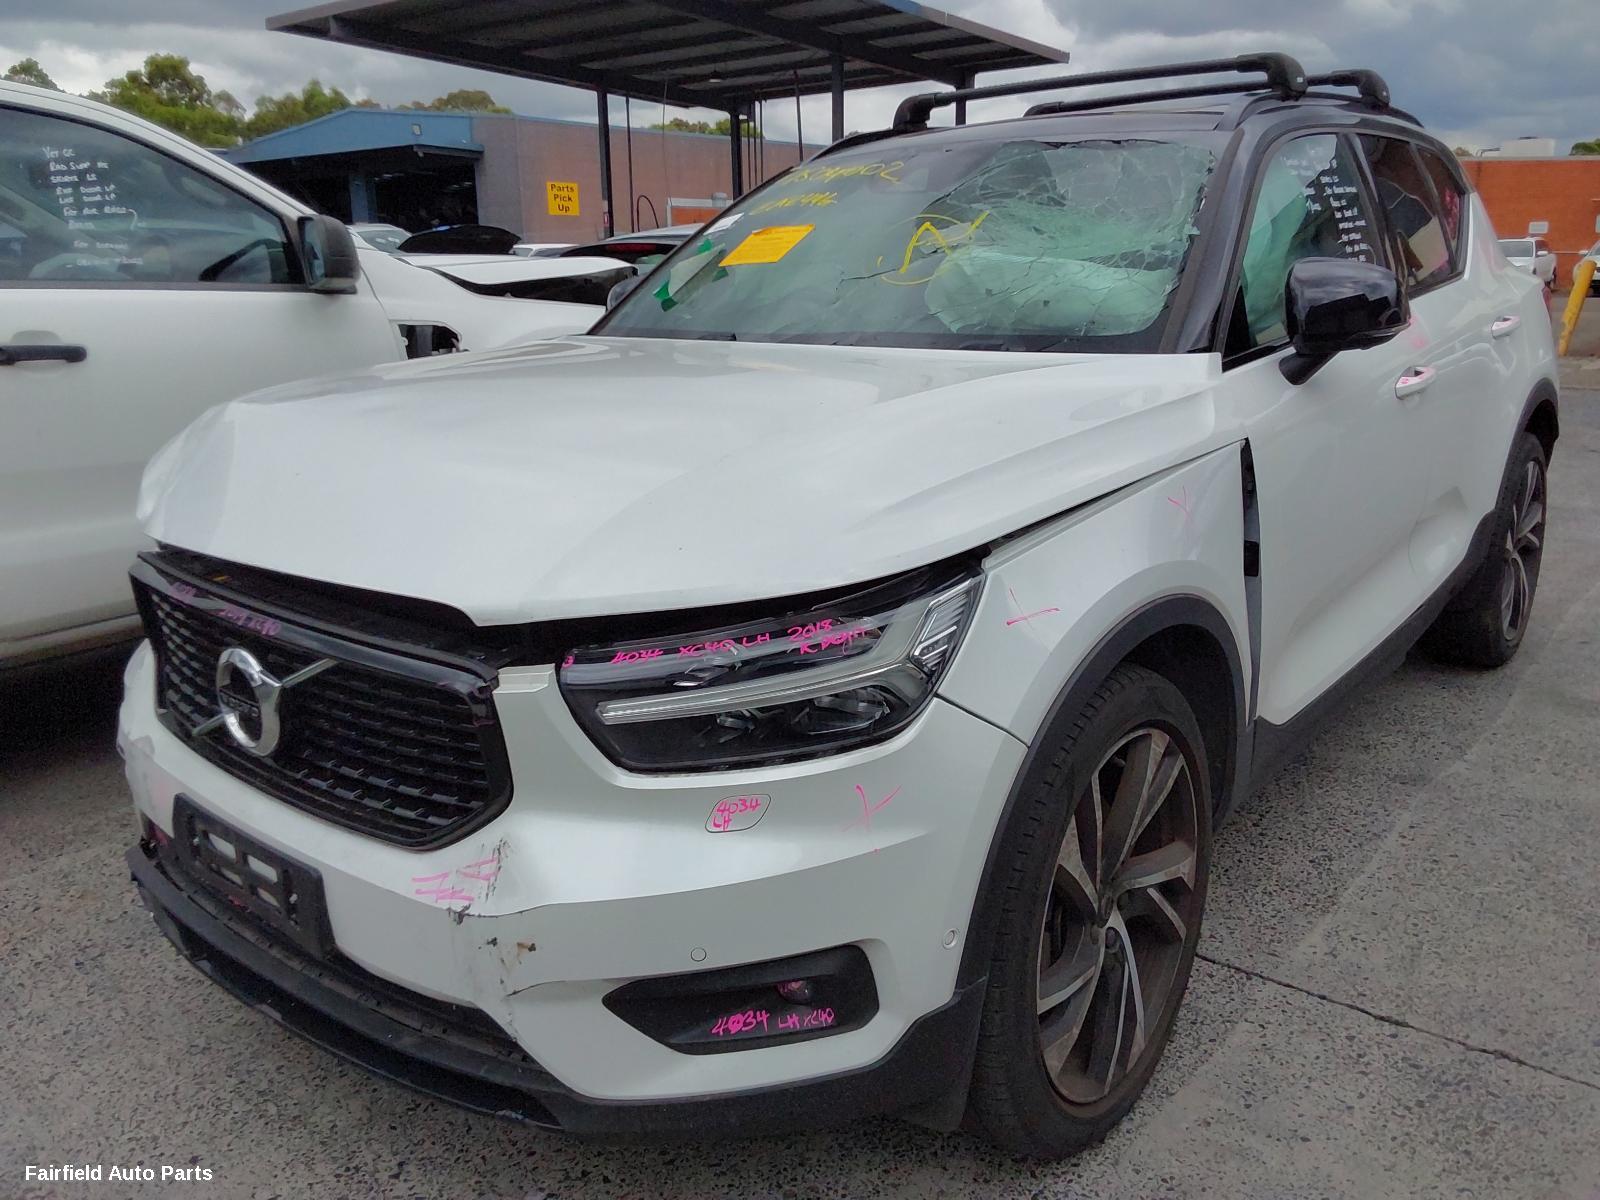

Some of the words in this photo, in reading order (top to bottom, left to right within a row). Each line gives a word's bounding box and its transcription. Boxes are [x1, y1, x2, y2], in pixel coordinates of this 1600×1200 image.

[550, 183, 575, 192] Parts
[553, 193, 573, 202] Pick
[557, 203, 570, 213] Up
[610, 648, 664, 665] 4034
[678, 640, 736, 658] XC40
[742, 632, 770, 648] LH
[786, 618, 833, 642] 2018
[715, 798, 762, 815] 4034
[712, 812, 733, 833] LH
[710, 1009, 770, 1036] 4034
[778, 1012, 801, 1030] LH
